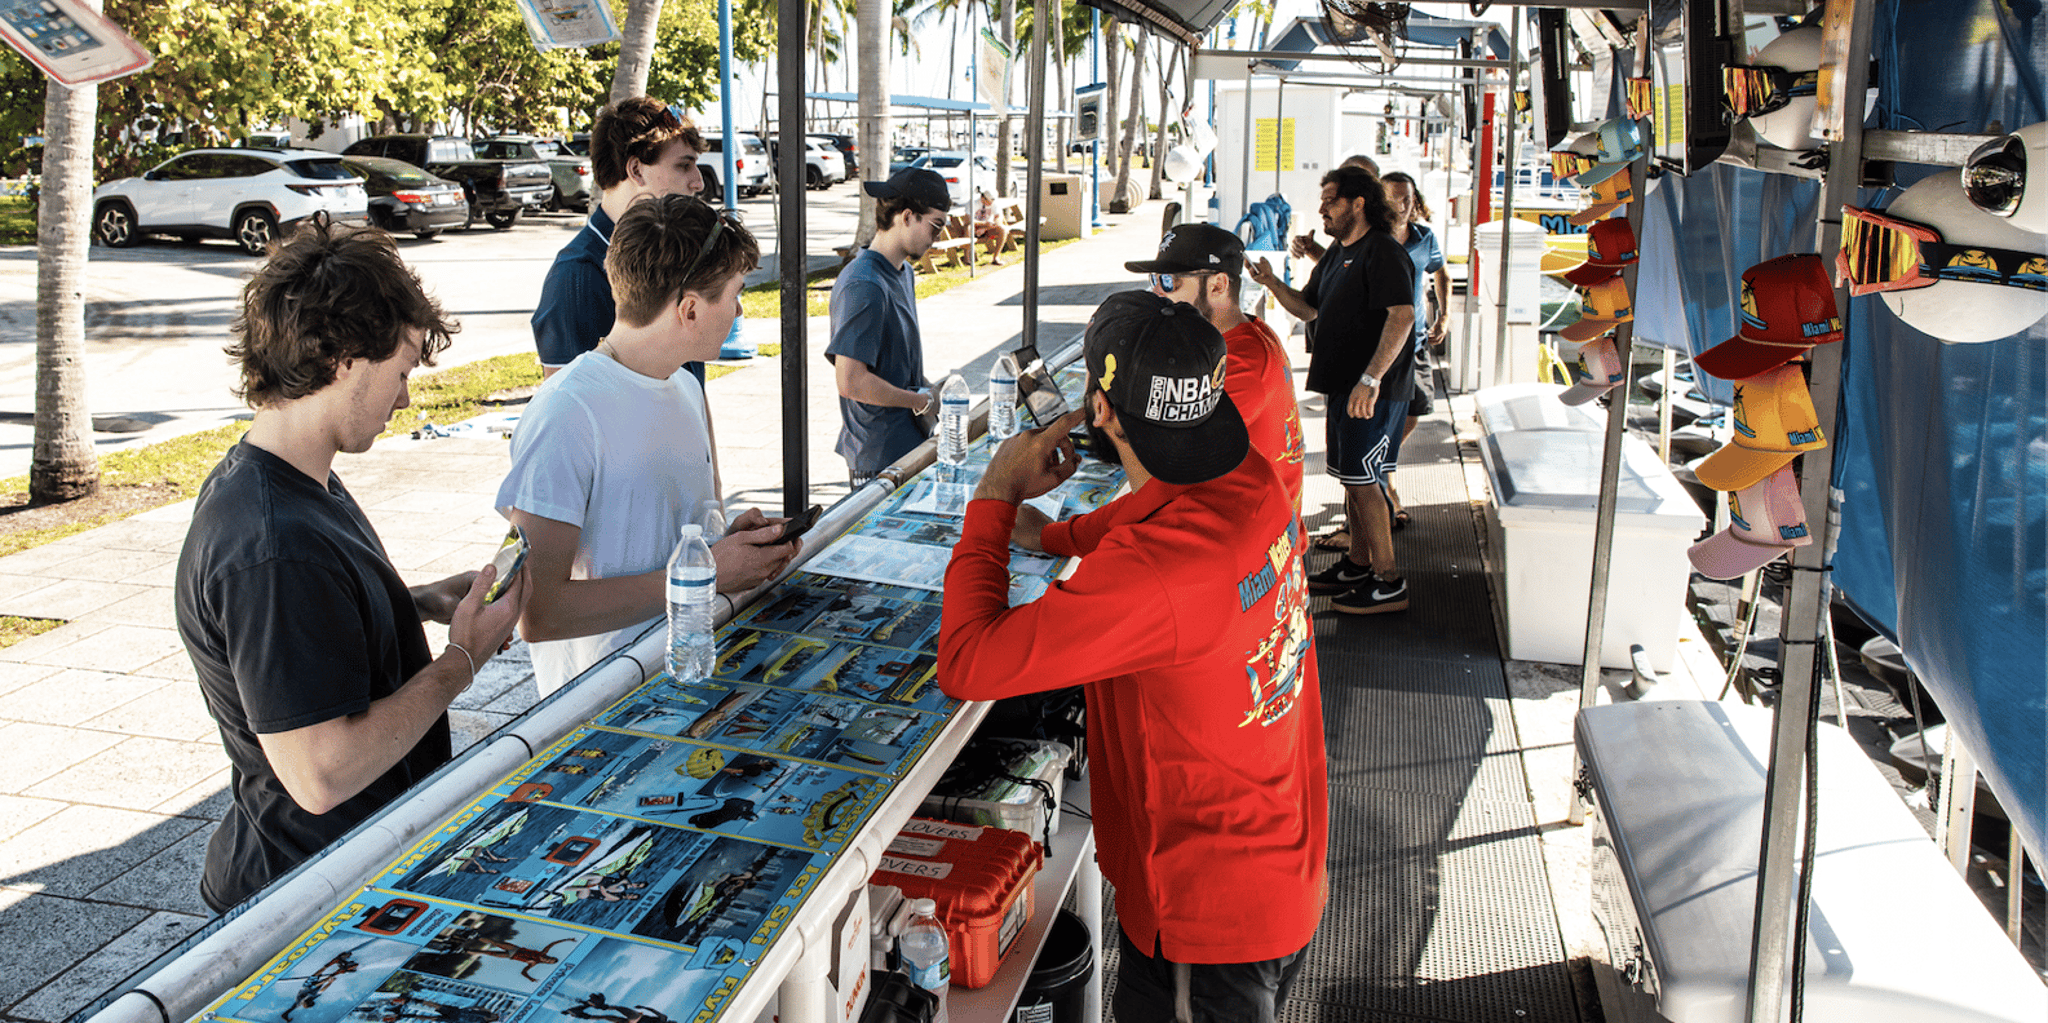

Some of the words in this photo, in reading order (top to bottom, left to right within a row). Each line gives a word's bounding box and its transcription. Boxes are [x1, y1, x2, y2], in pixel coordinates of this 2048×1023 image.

[1801, 319, 1831, 337] Miami
[1148, 378, 1164, 418] 2016
[1165, 374, 1212, 403] NBA
[1788, 428, 1818, 446] Miami
[1237, 552, 1277, 613] Miami
[442, 804, 486, 836] Jet
[828, 782, 889, 844] Parasail
[391, 840, 441, 875] Ski
[785, 864, 822, 899] Jet
[750, 905, 790, 946] Ski
[236, 902, 366, 1001] Flyboard
